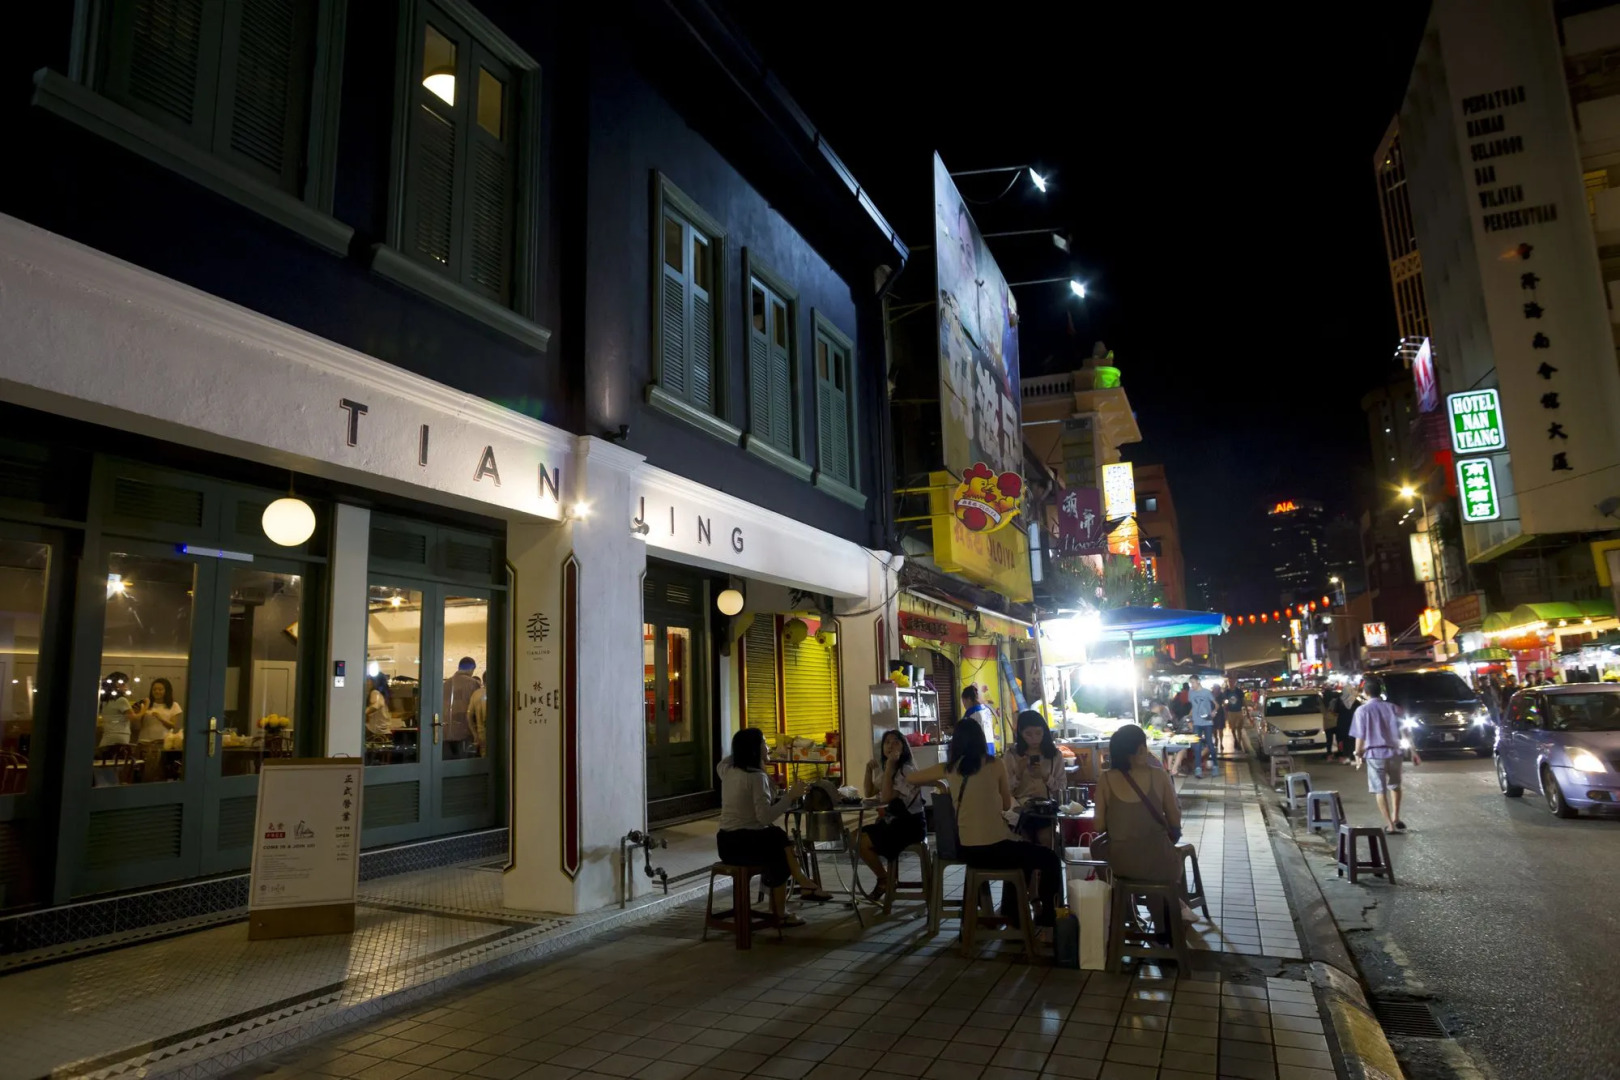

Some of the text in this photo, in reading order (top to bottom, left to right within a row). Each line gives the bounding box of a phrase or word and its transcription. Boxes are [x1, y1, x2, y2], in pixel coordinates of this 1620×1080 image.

[1483, 203, 1558, 233] PERSEKUTUAN
[1452, 393, 1495, 415] HOTEL
[1461, 411, 1490, 431] NAN
[1457, 428, 1500, 449] YEANG
[339, 397, 744, 554] TIAN JING
[1274, 501, 1295, 514] AIA
[1365, 624, 1382, 635] KK
[517, 689, 559, 711] LINKEE
